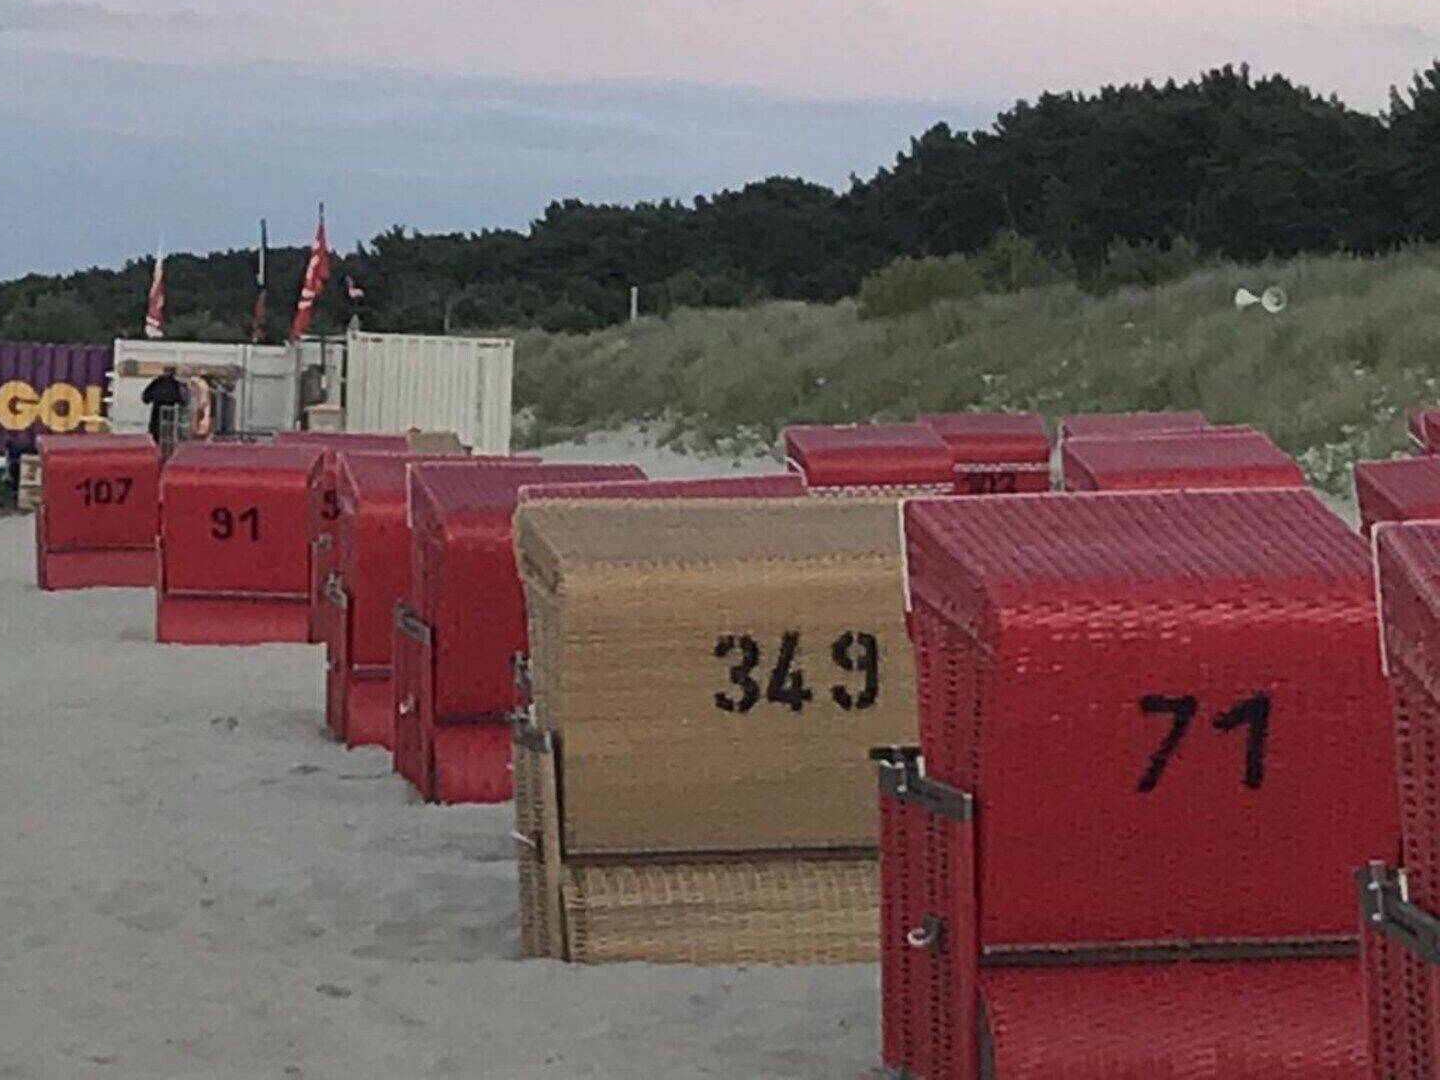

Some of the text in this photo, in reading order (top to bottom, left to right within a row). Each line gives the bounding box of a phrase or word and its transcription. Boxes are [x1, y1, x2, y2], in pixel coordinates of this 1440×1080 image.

[75, 477, 133, 506] 107
[211, 507, 259, 541] 91
[712, 630, 879, 712] 349
[1137, 694, 1271, 792] 71
